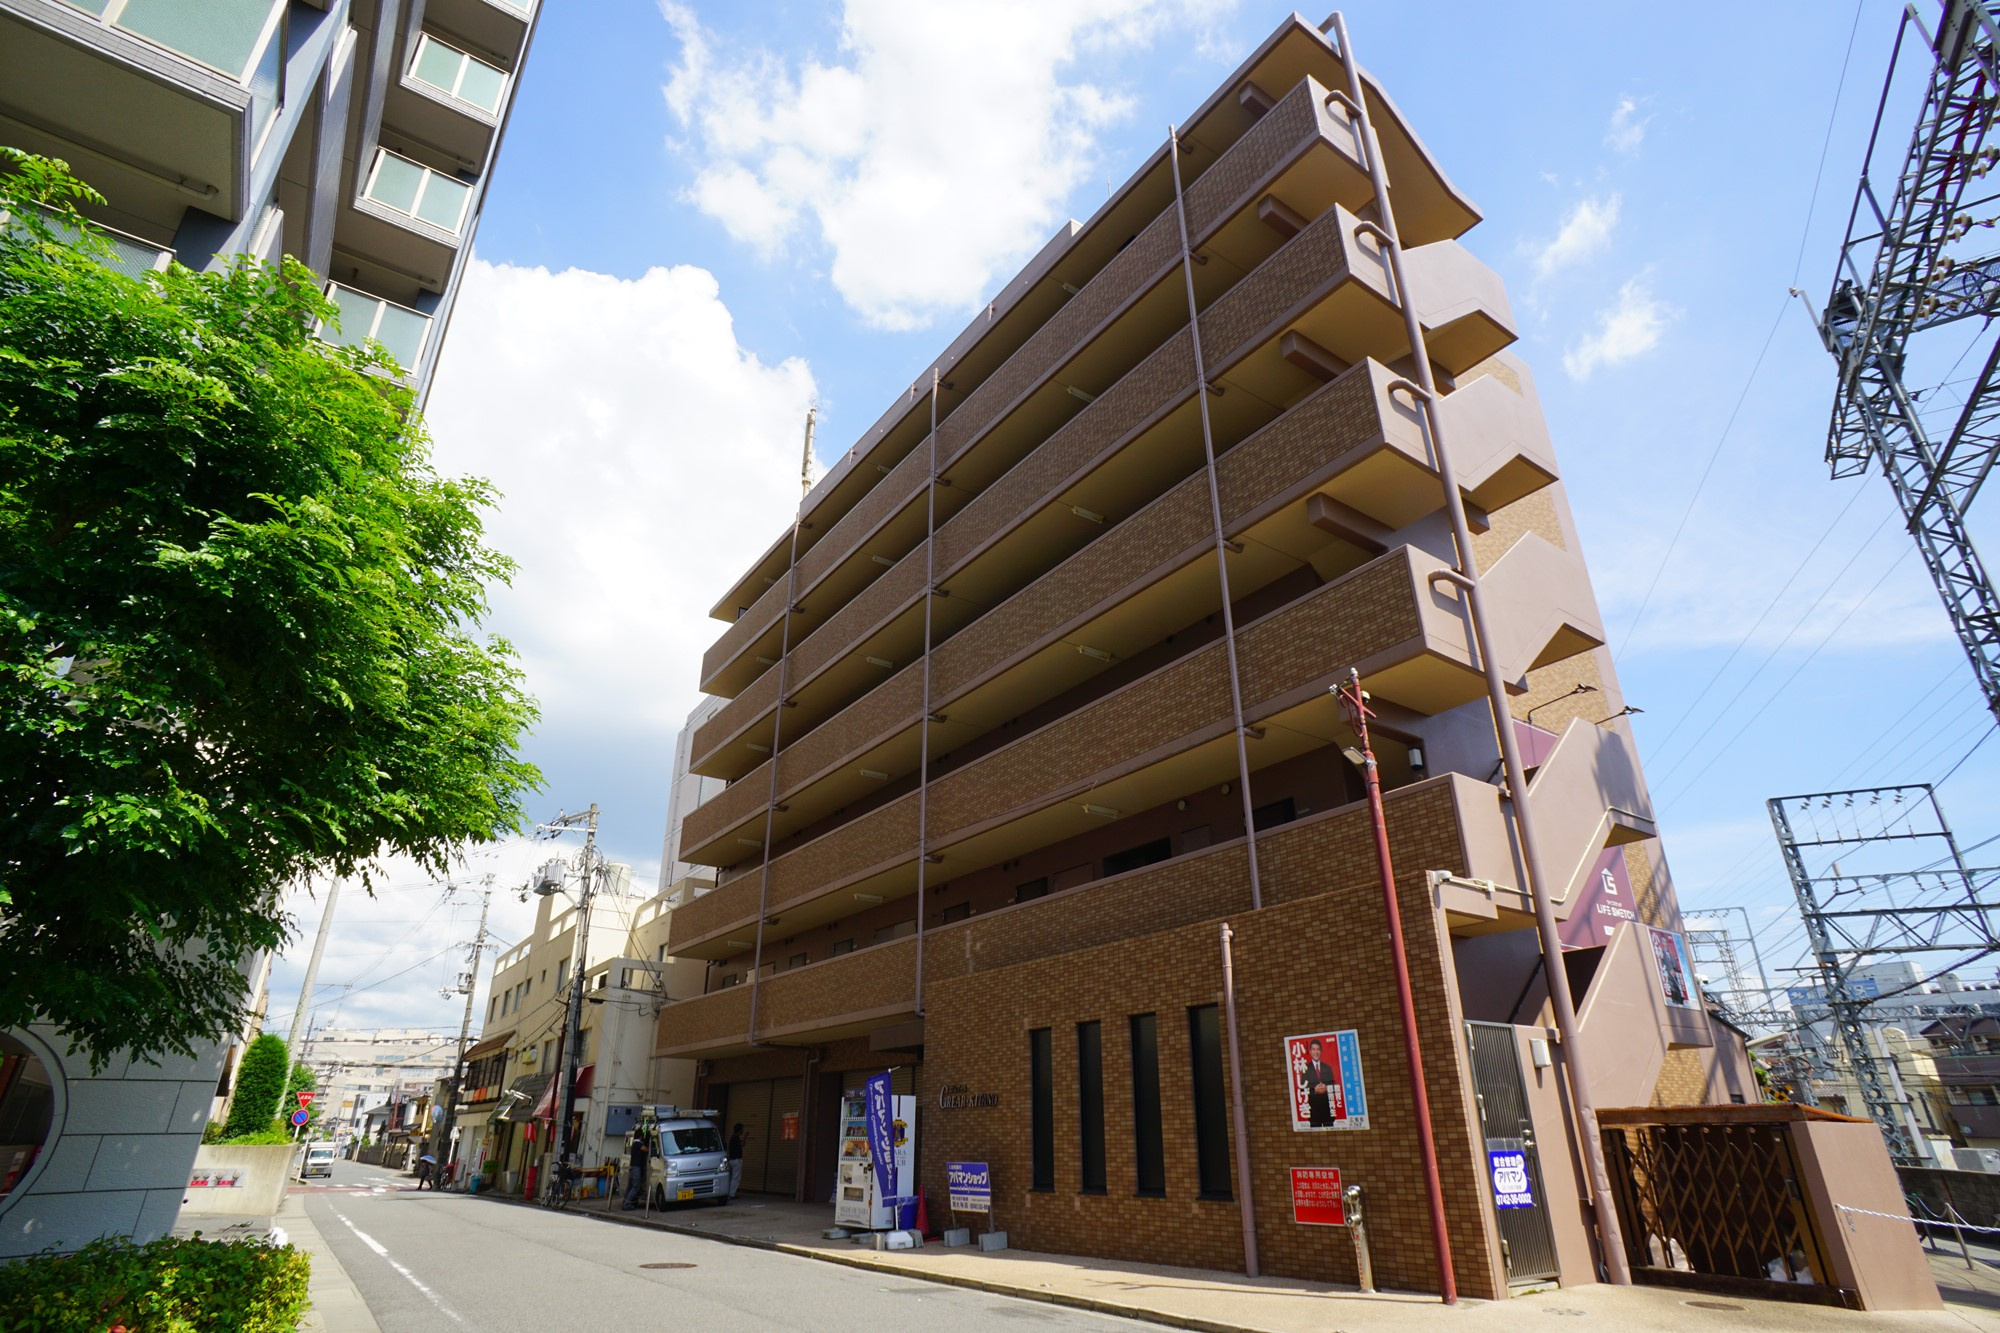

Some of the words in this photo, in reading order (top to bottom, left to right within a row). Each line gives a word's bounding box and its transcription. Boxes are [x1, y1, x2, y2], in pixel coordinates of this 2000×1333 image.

[1611, 907, 1636, 920] SKETCH
[1292, 1041, 1312, 1119] 小林しげき
[949, 1171, 987, 1185] アパマンショップ
[1497, 1171, 1523, 1183] アパマン
